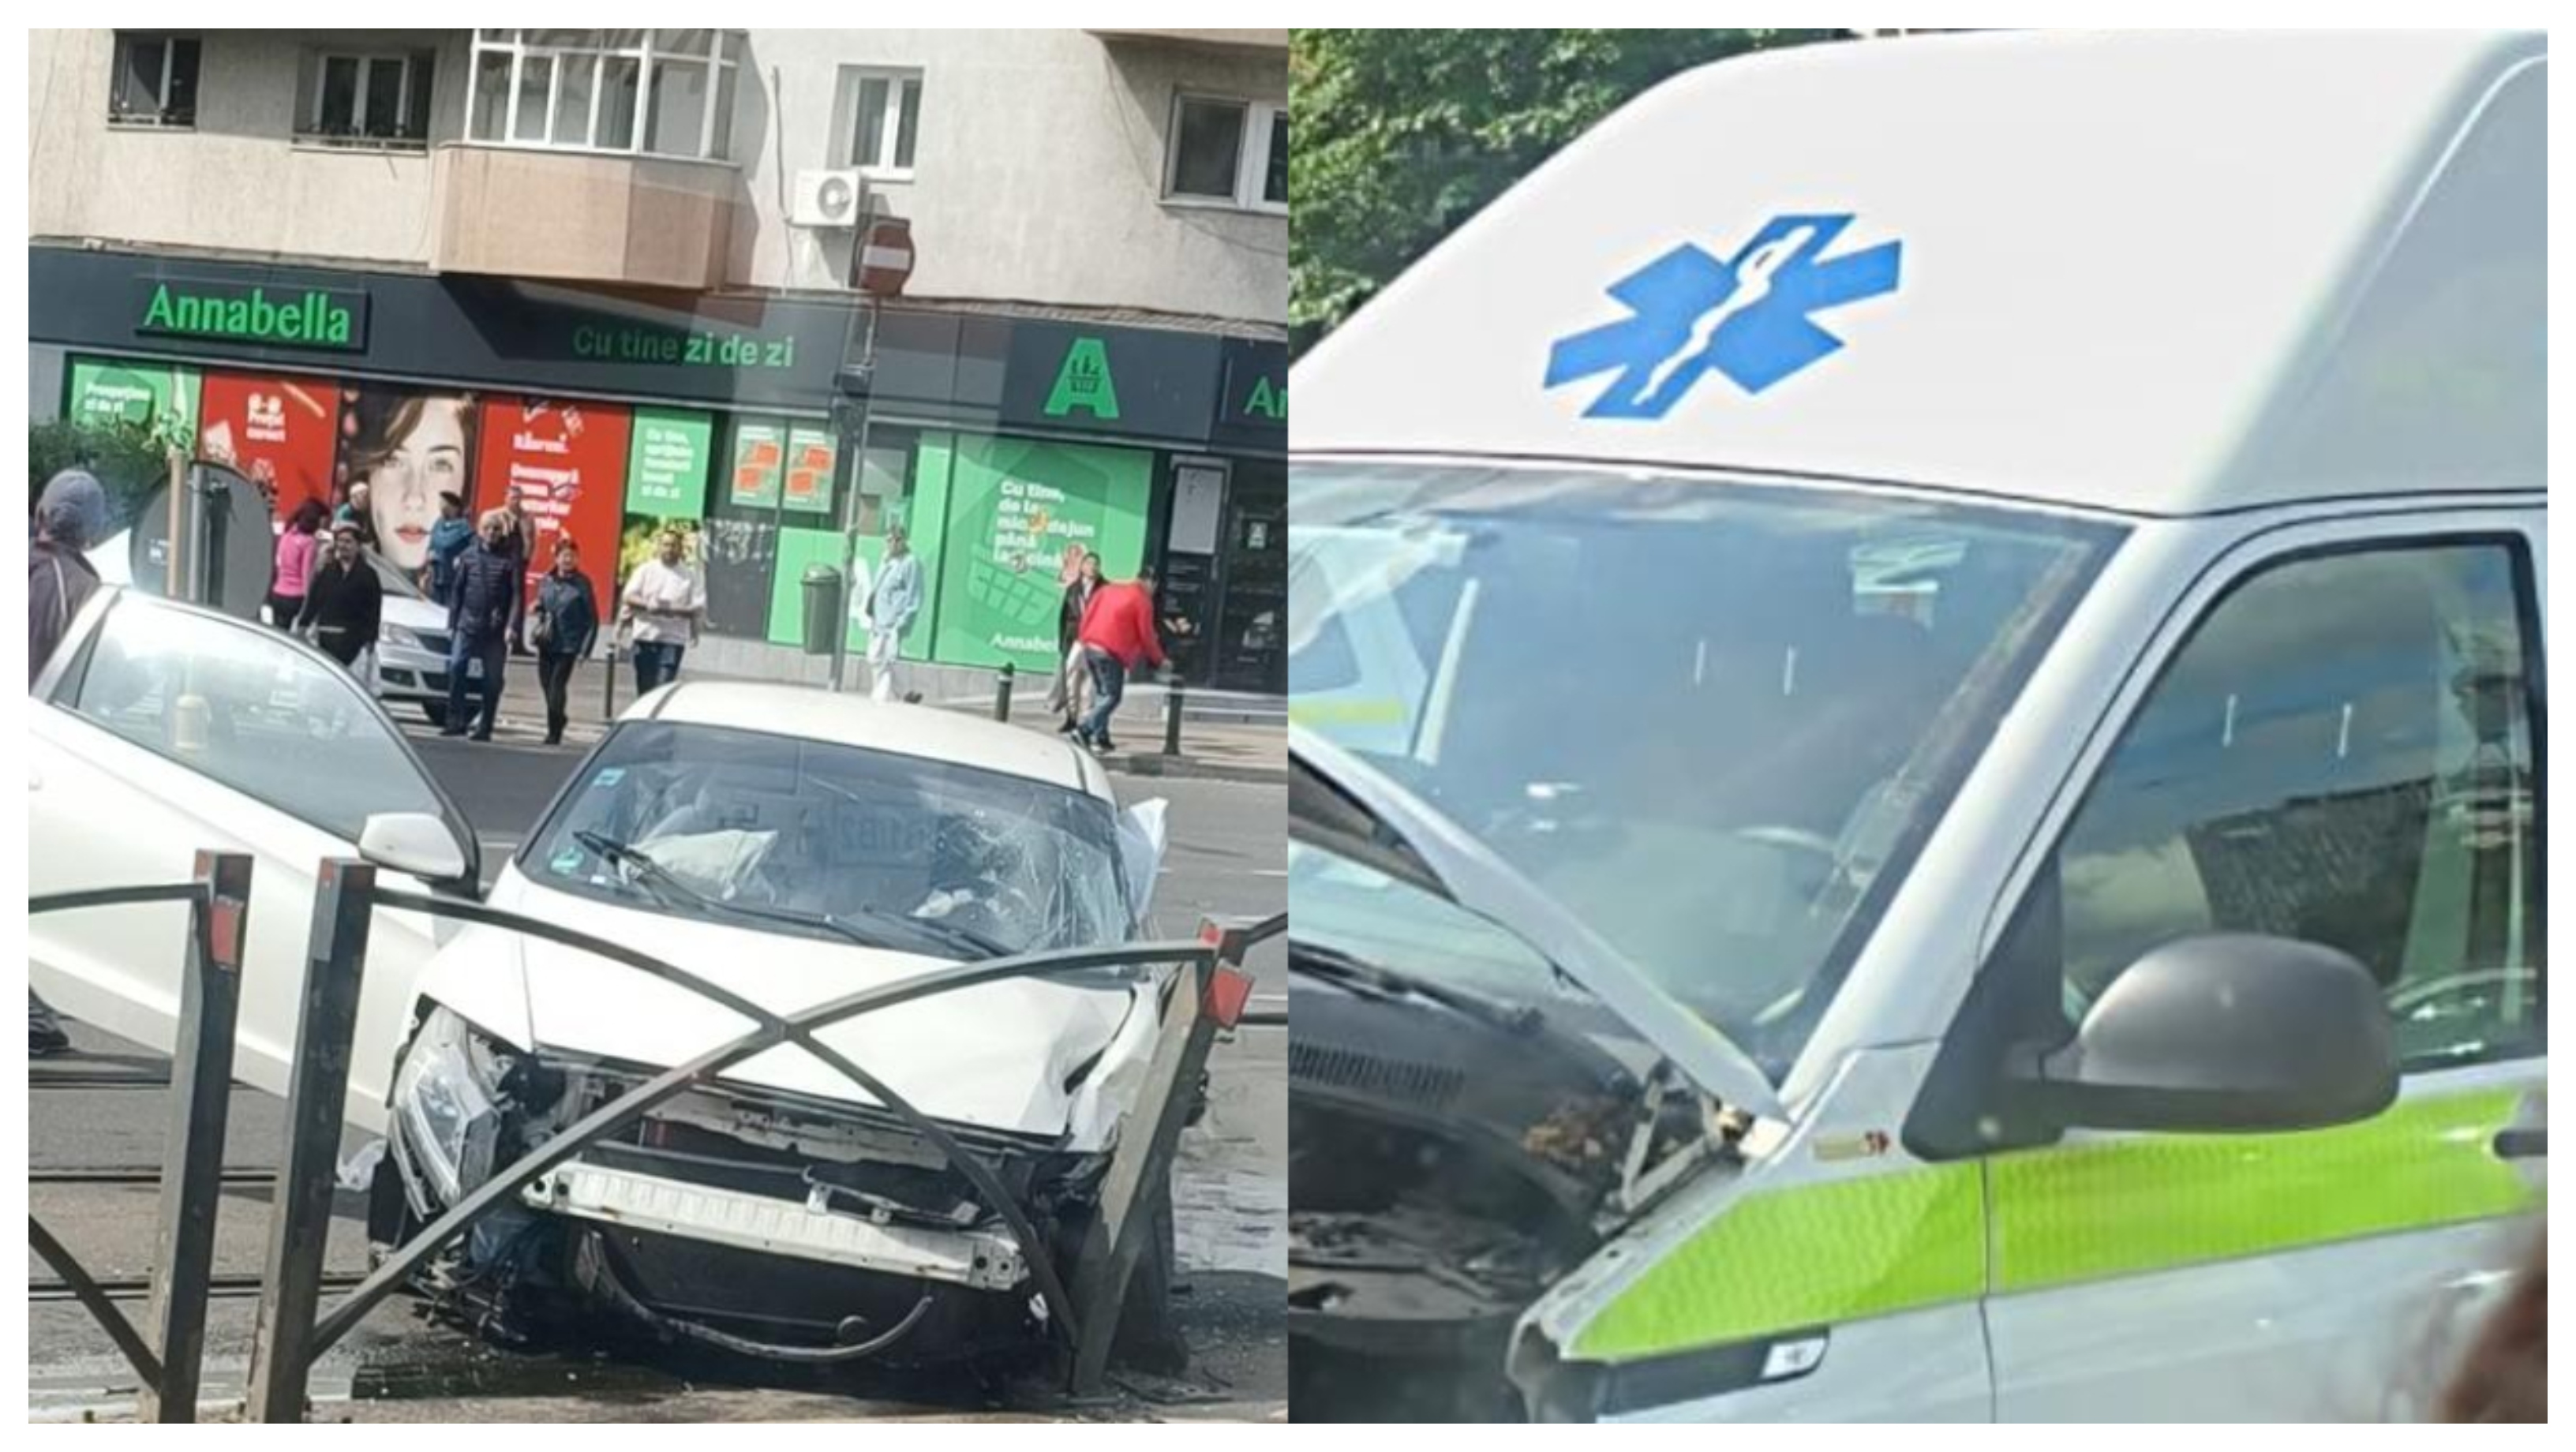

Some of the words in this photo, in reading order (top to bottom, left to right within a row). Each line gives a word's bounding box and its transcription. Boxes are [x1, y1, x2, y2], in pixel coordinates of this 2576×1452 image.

[144, 283, 350, 342] Annabella
[574, 326, 611, 355] Cu
[620, 329, 679, 360] tine
[683, 331, 714, 363] zi
[719, 333, 758, 365] de
[763, 336, 795, 367] zi
[1001, 480, 1024, 496] Cu
[998, 498, 1020, 513] de
